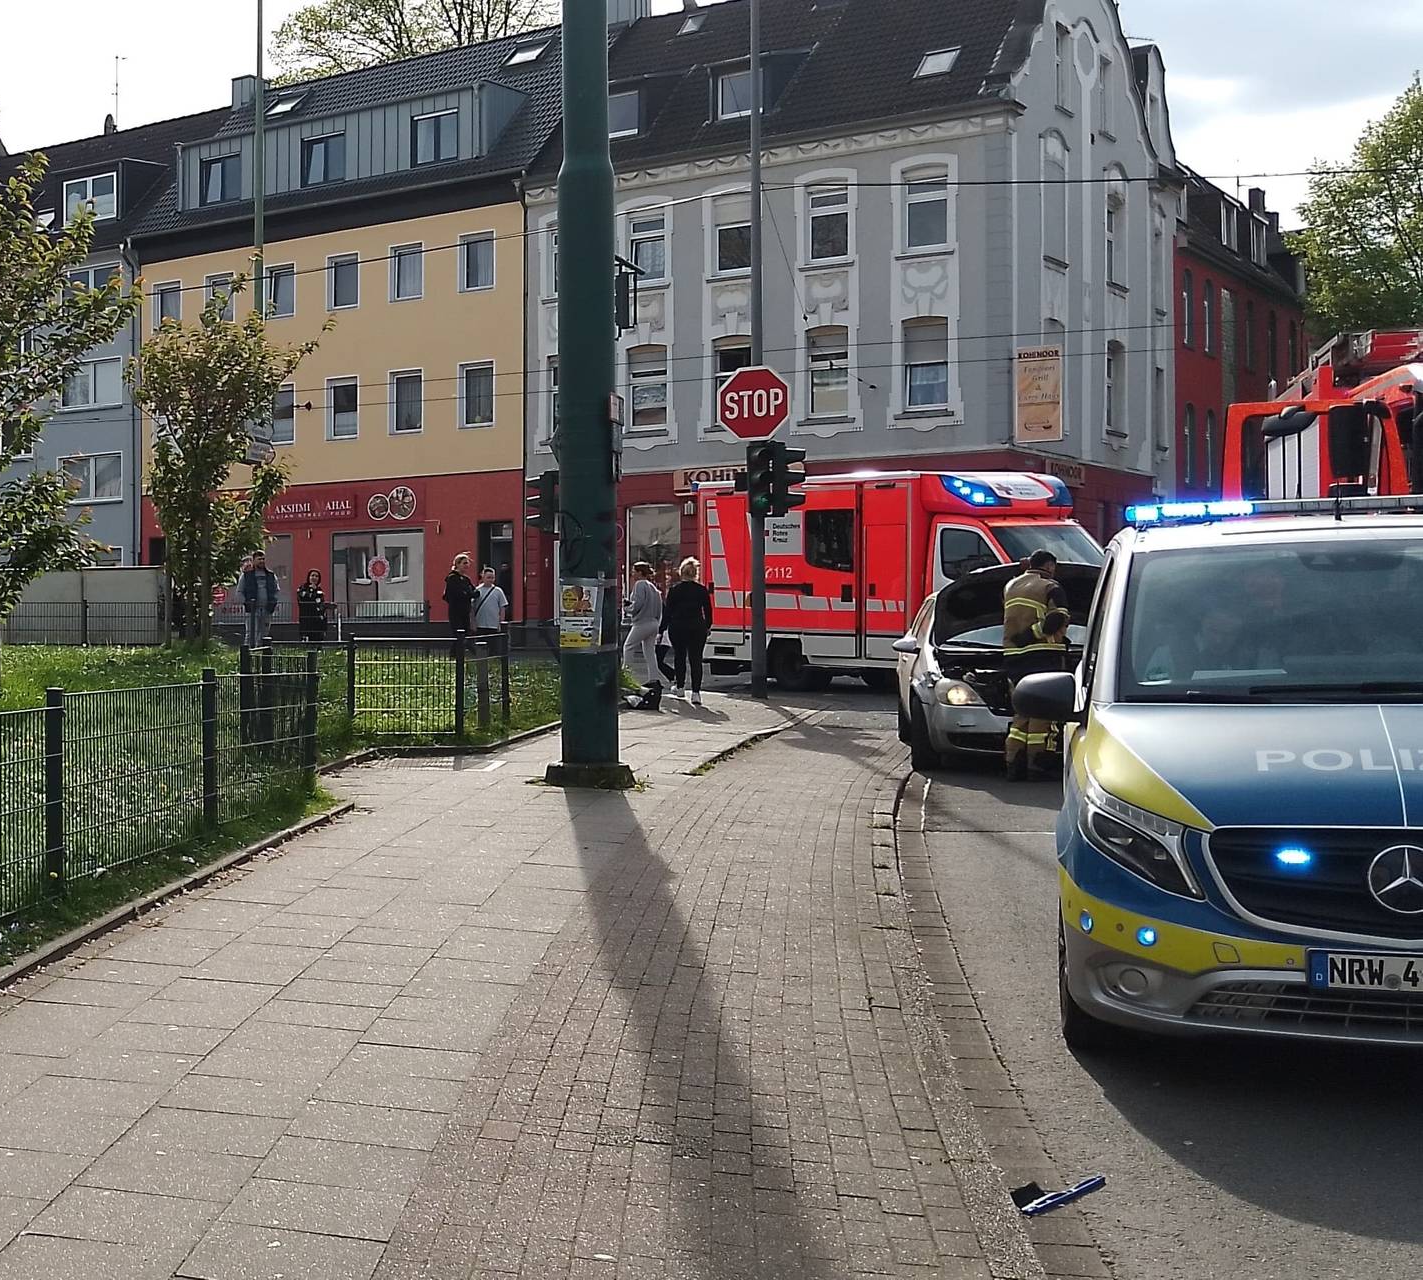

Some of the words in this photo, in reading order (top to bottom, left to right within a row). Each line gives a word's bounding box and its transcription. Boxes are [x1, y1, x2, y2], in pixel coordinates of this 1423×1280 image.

[1018, 349, 1060, 359] KOHINOOR
[724, 388, 783, 419] STOP
[683, 466, 746, 486] KOHI
[775, 566, 793, 579] 112
[1255, 749, 1423, 772] POLI
[1315, 973, 1323, 981] D
[1329, 957, 1385, 986] NRW
[1403, 960, 1419, 987] 4
